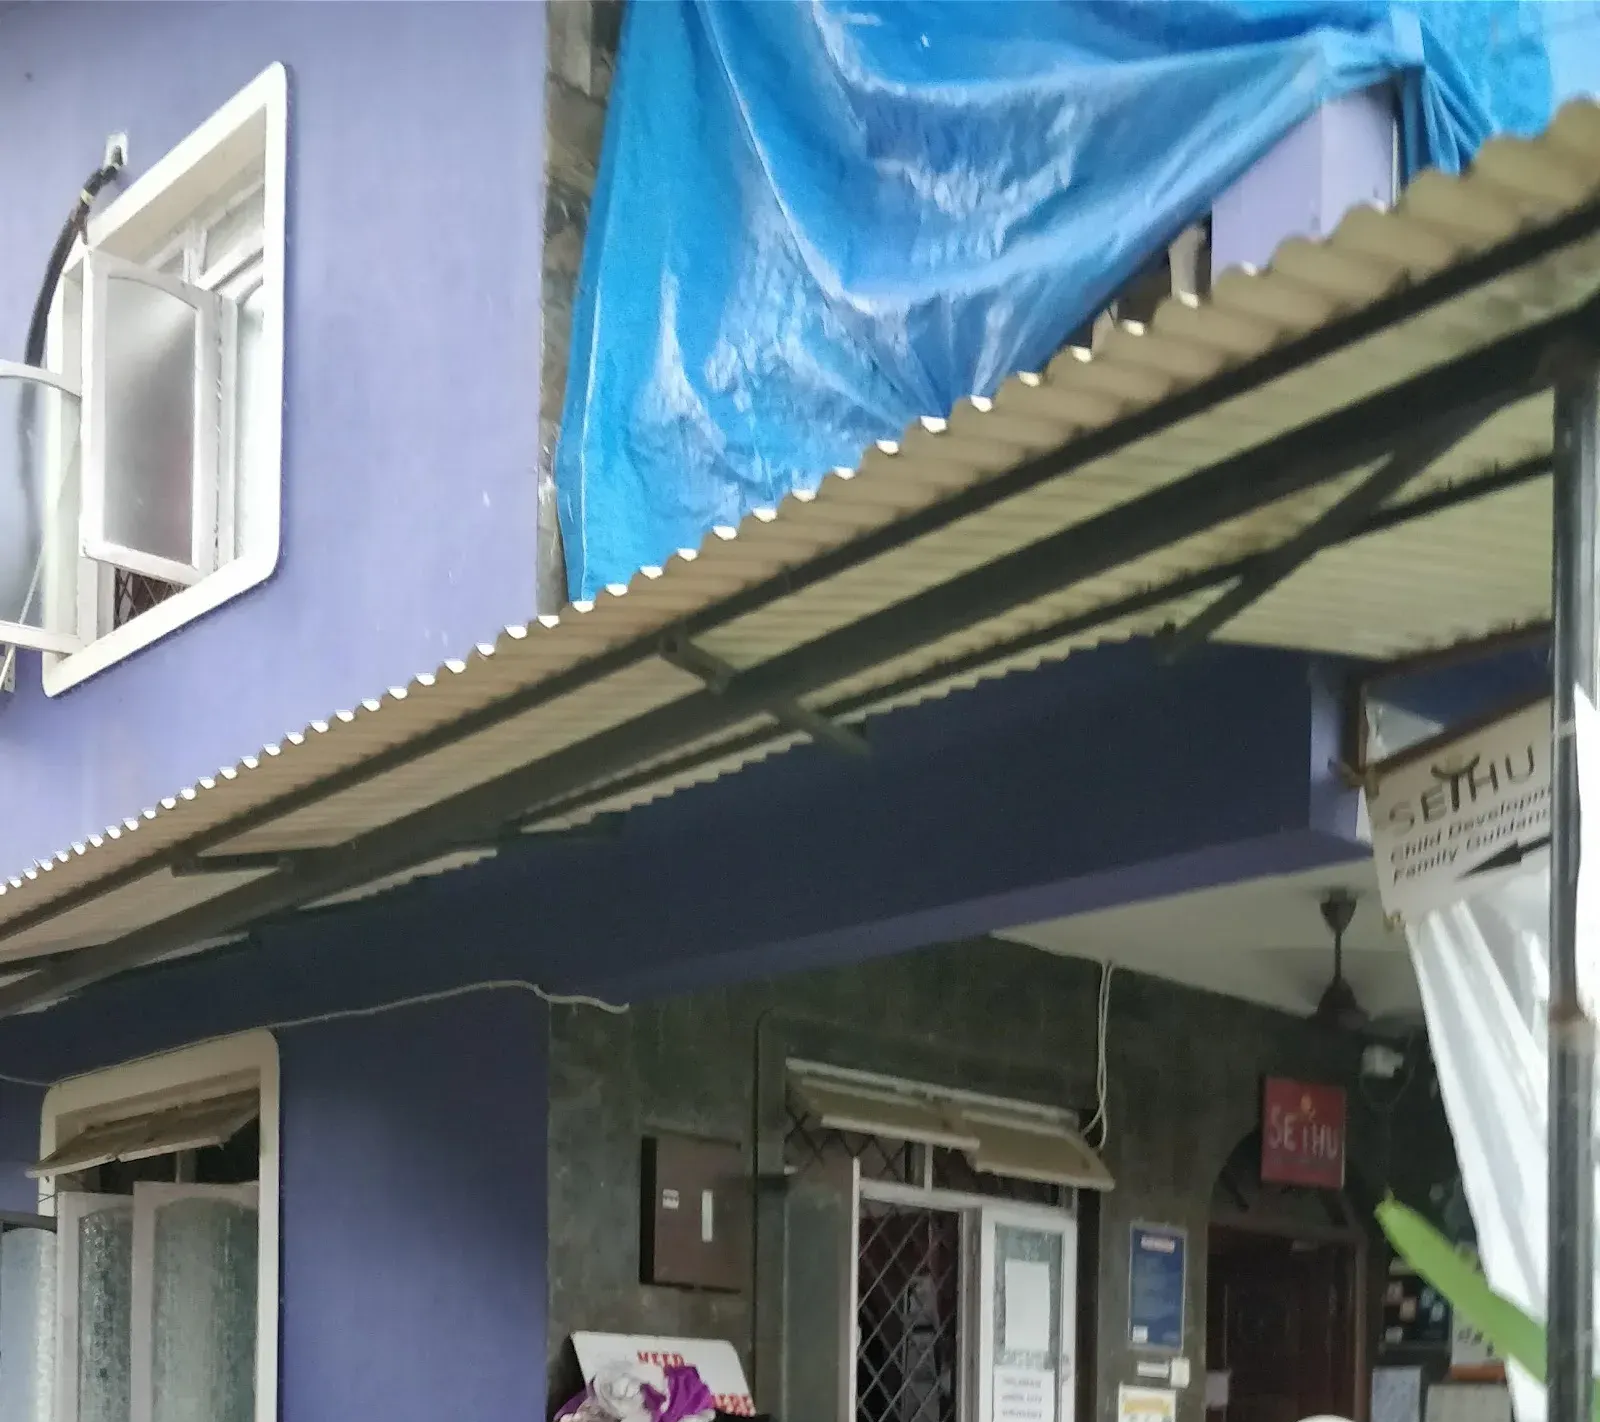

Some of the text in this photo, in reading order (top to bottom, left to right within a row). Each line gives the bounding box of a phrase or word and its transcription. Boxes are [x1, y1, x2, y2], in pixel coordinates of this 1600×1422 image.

[1389, 744, 1536, 837] SETHU
[1390, 784, 1551, 866] Child Developm
[1393, 847, 1459, 886] Family
[1268, 1104, 1339, 1160] SETHU
